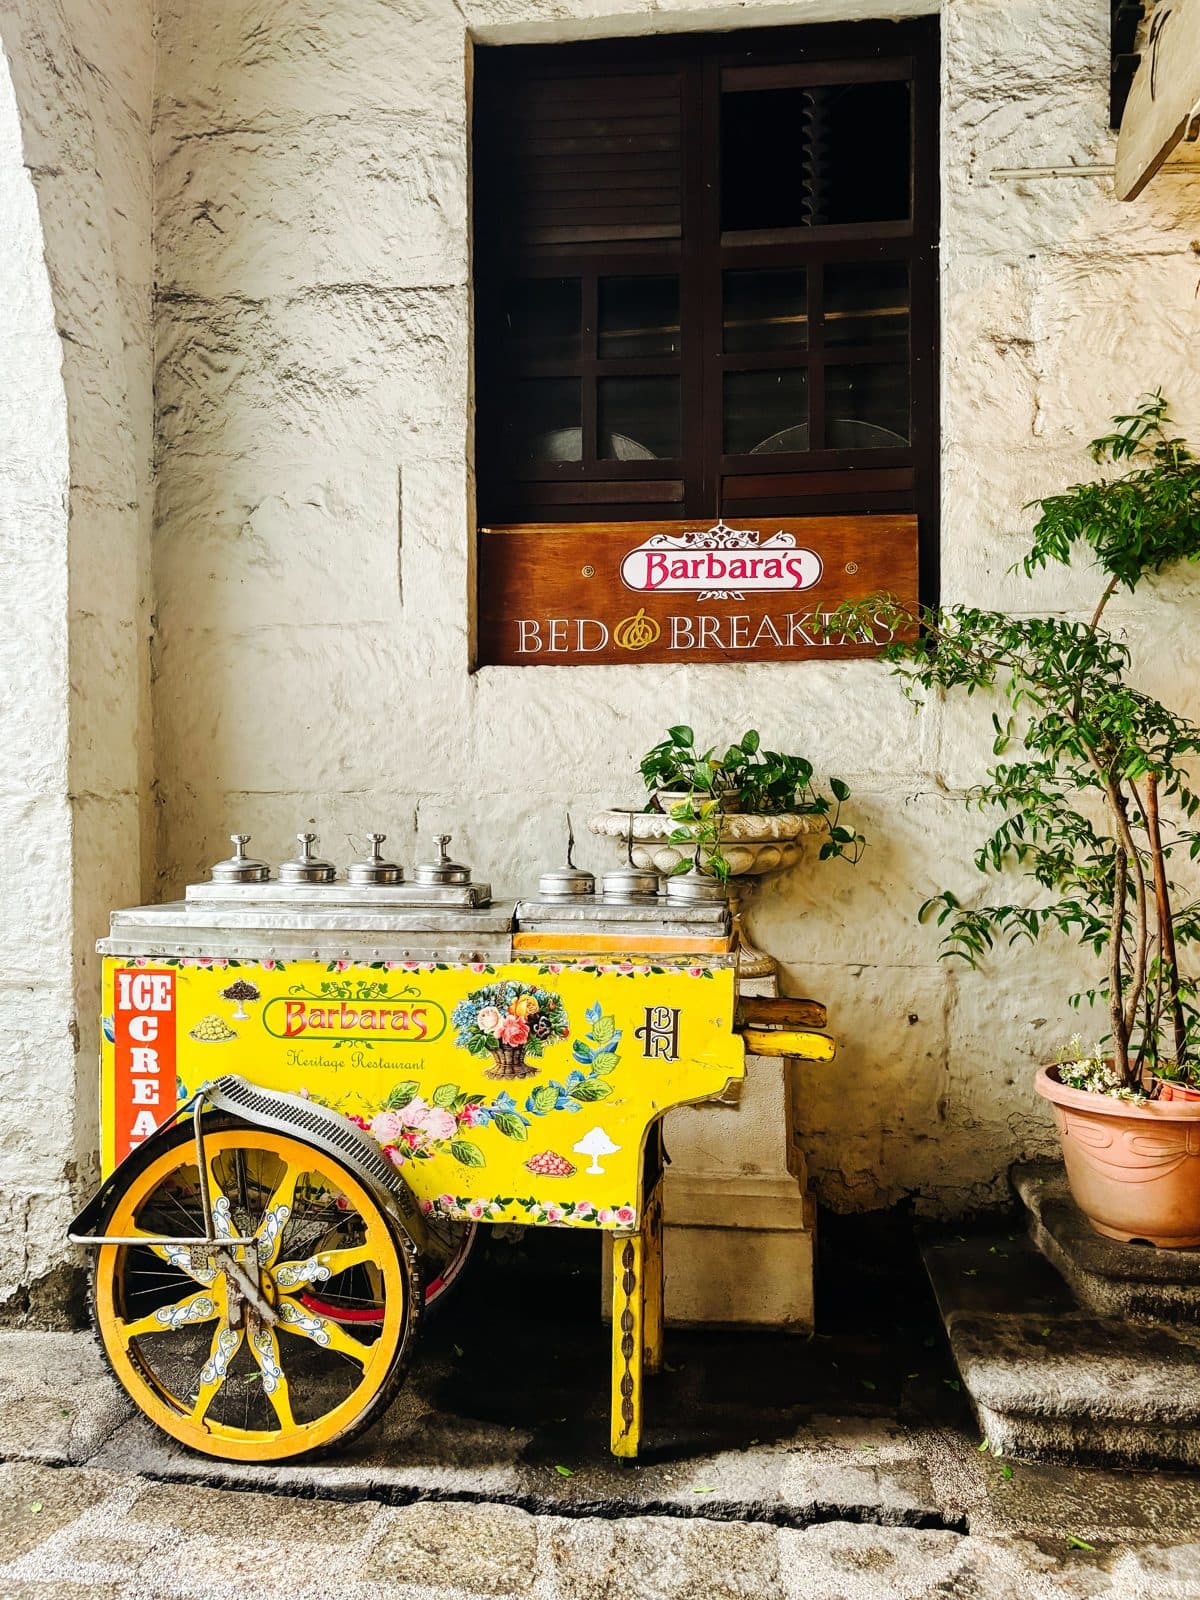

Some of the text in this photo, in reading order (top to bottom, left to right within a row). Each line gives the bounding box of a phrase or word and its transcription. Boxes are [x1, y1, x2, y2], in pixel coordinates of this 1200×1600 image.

[644, 552, 801, 590] Barbara's
[514, 617, 609, 654] BED
[118, 973, 172, 1012] ICE
[283, 1001, 428, 1041] Barbara's
[286, 1049, 426, 1072] Heritage Restaurant
[128, 1015, 161, 1151] CREA
